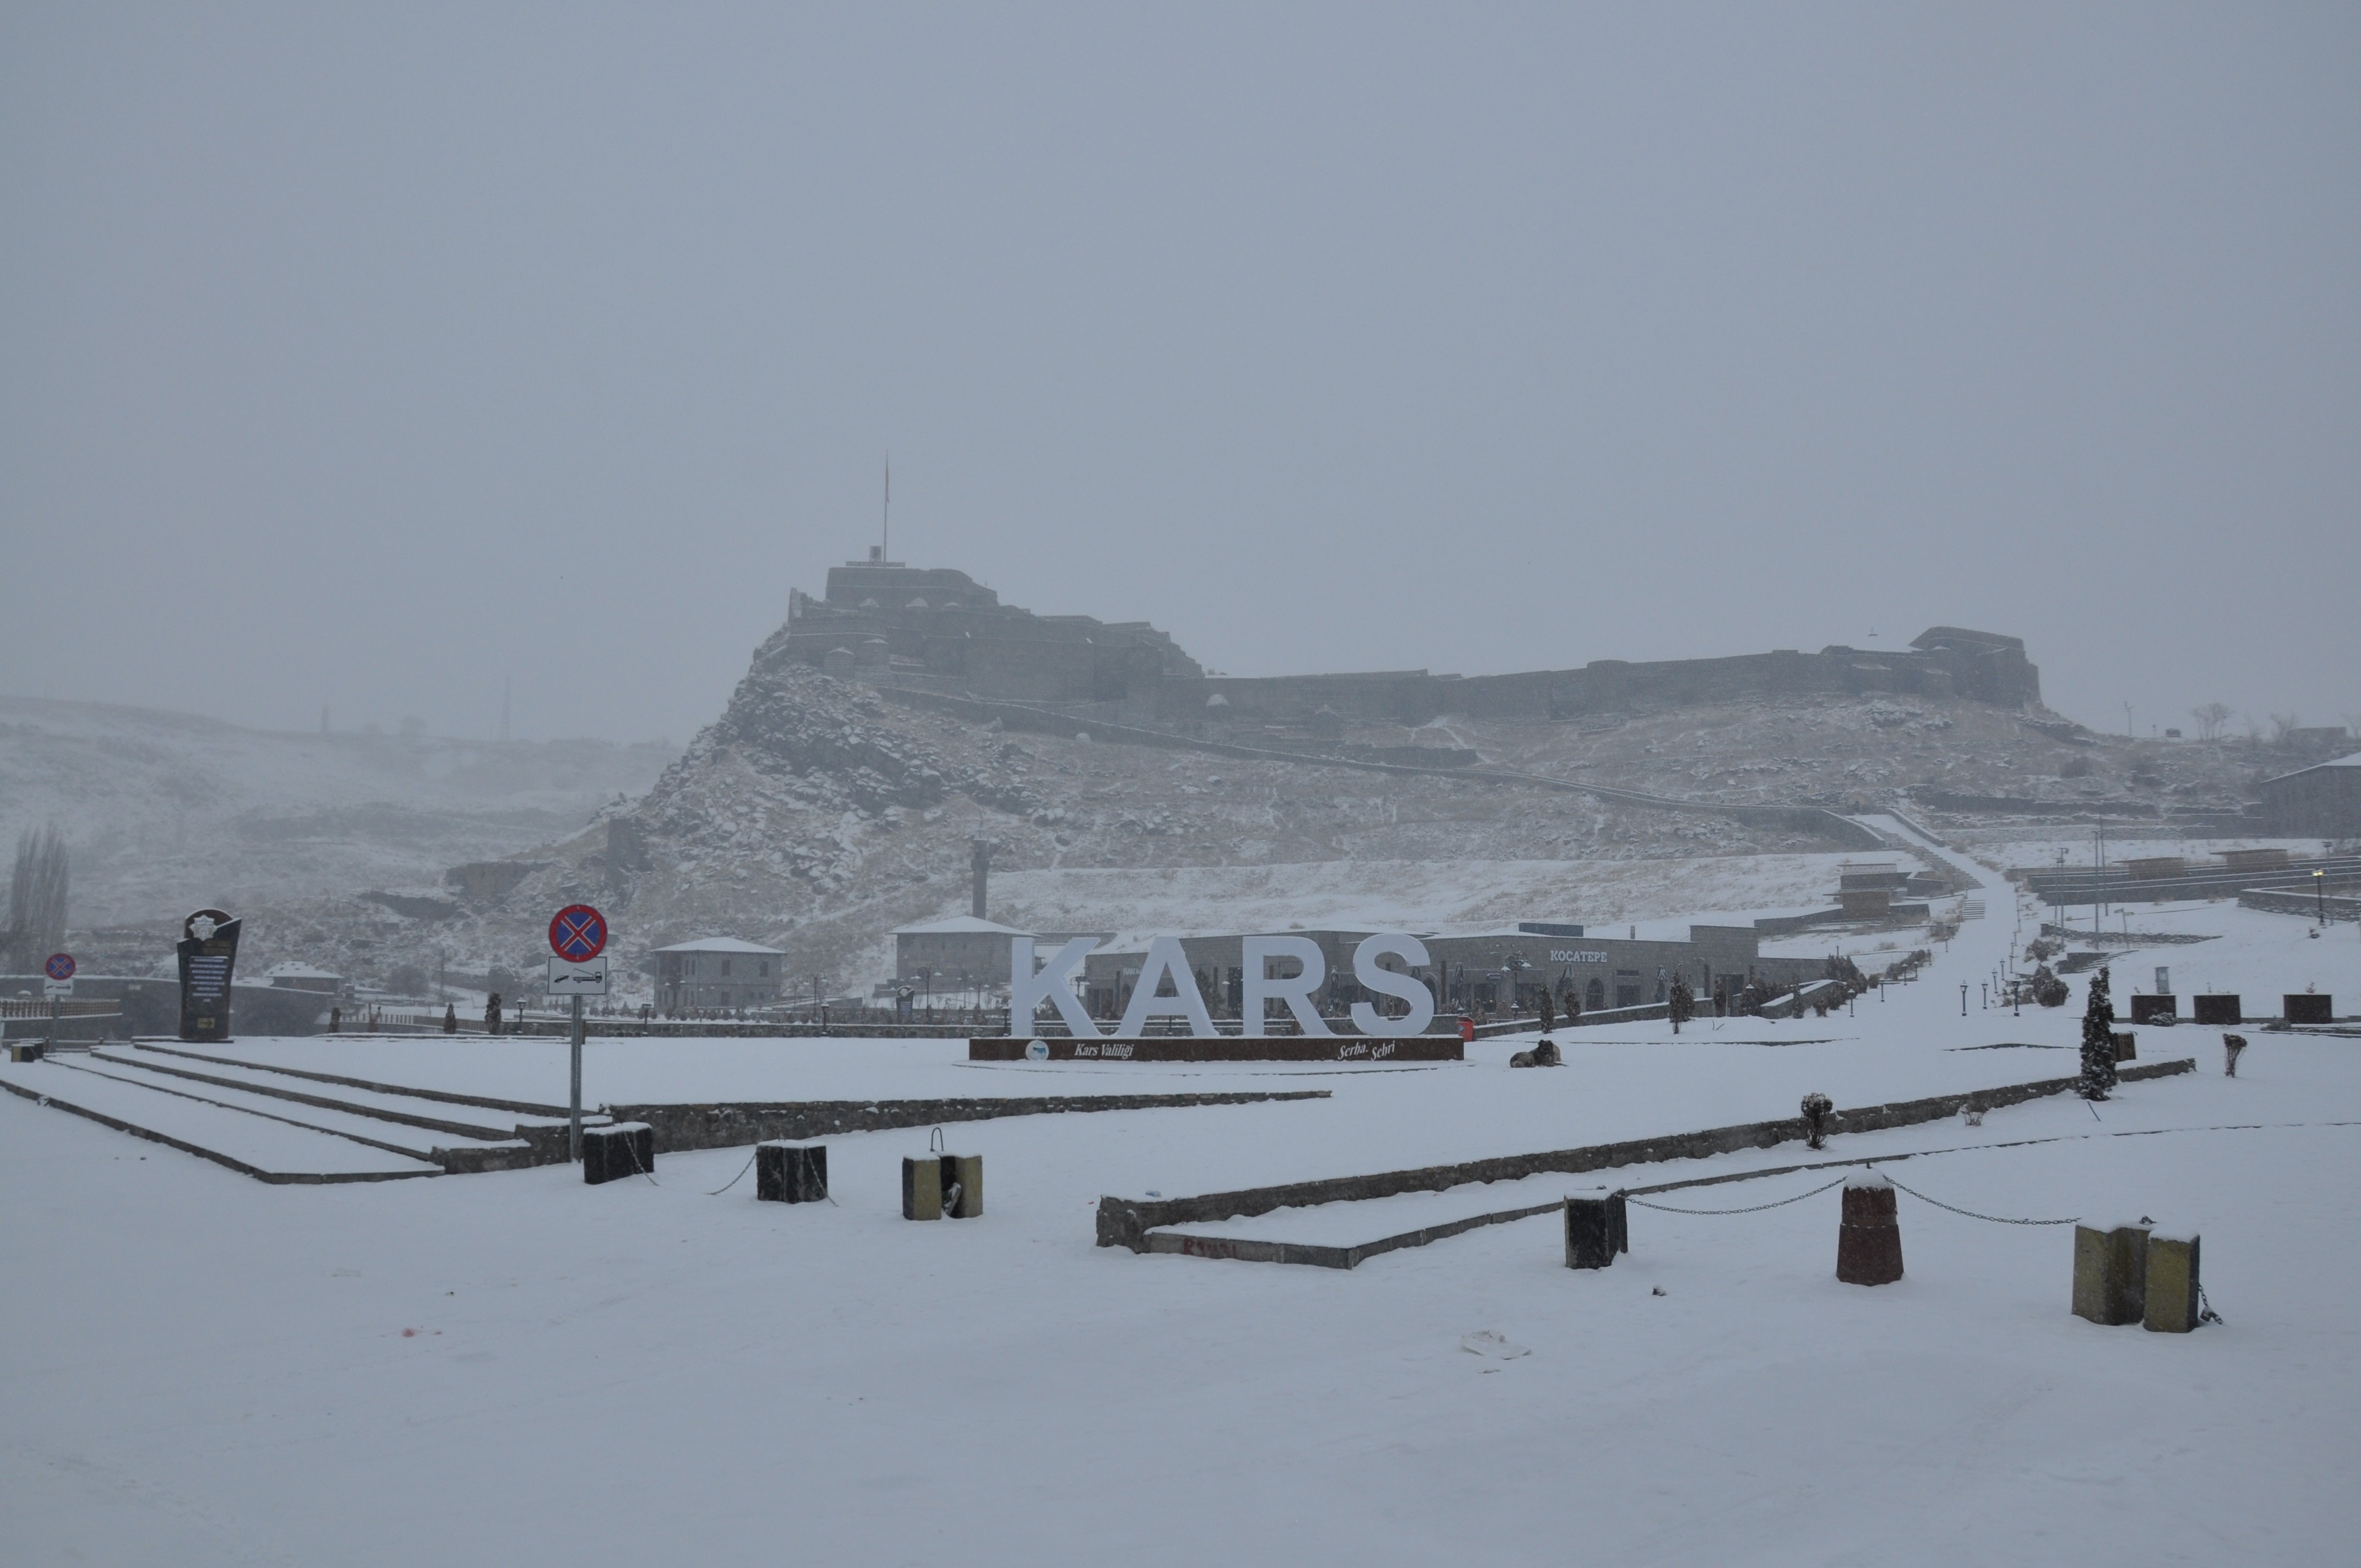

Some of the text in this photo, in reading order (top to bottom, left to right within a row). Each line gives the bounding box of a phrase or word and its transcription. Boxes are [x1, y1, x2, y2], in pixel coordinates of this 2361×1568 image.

[1550, 950, 1607, 962] KOCATEPE
[1011, 933, 1435, 1037] KARS
[1074, 1043, 1134, 1060] Kars Valiliği
